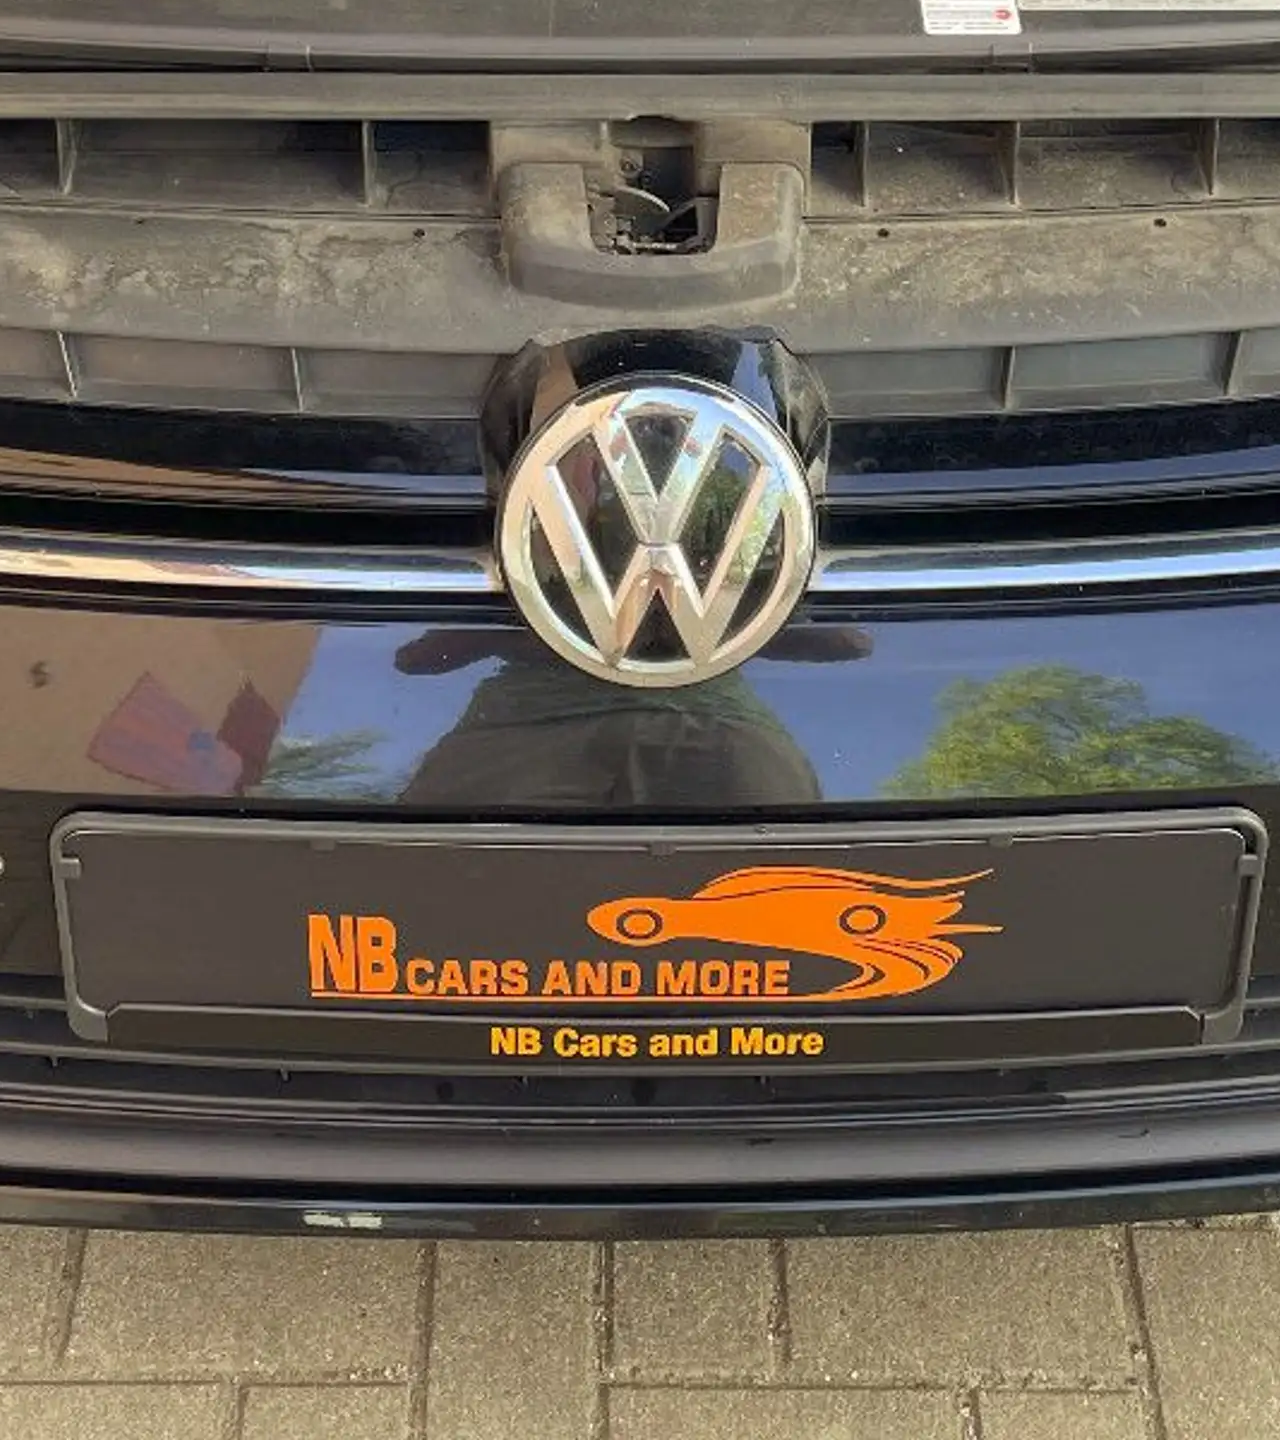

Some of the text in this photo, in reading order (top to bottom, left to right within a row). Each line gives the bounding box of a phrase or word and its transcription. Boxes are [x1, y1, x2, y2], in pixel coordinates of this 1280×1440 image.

[307, 913, 791, 995] NB CARS AND MORE
[490, 1027, 824, 1057] NB Cars and More
